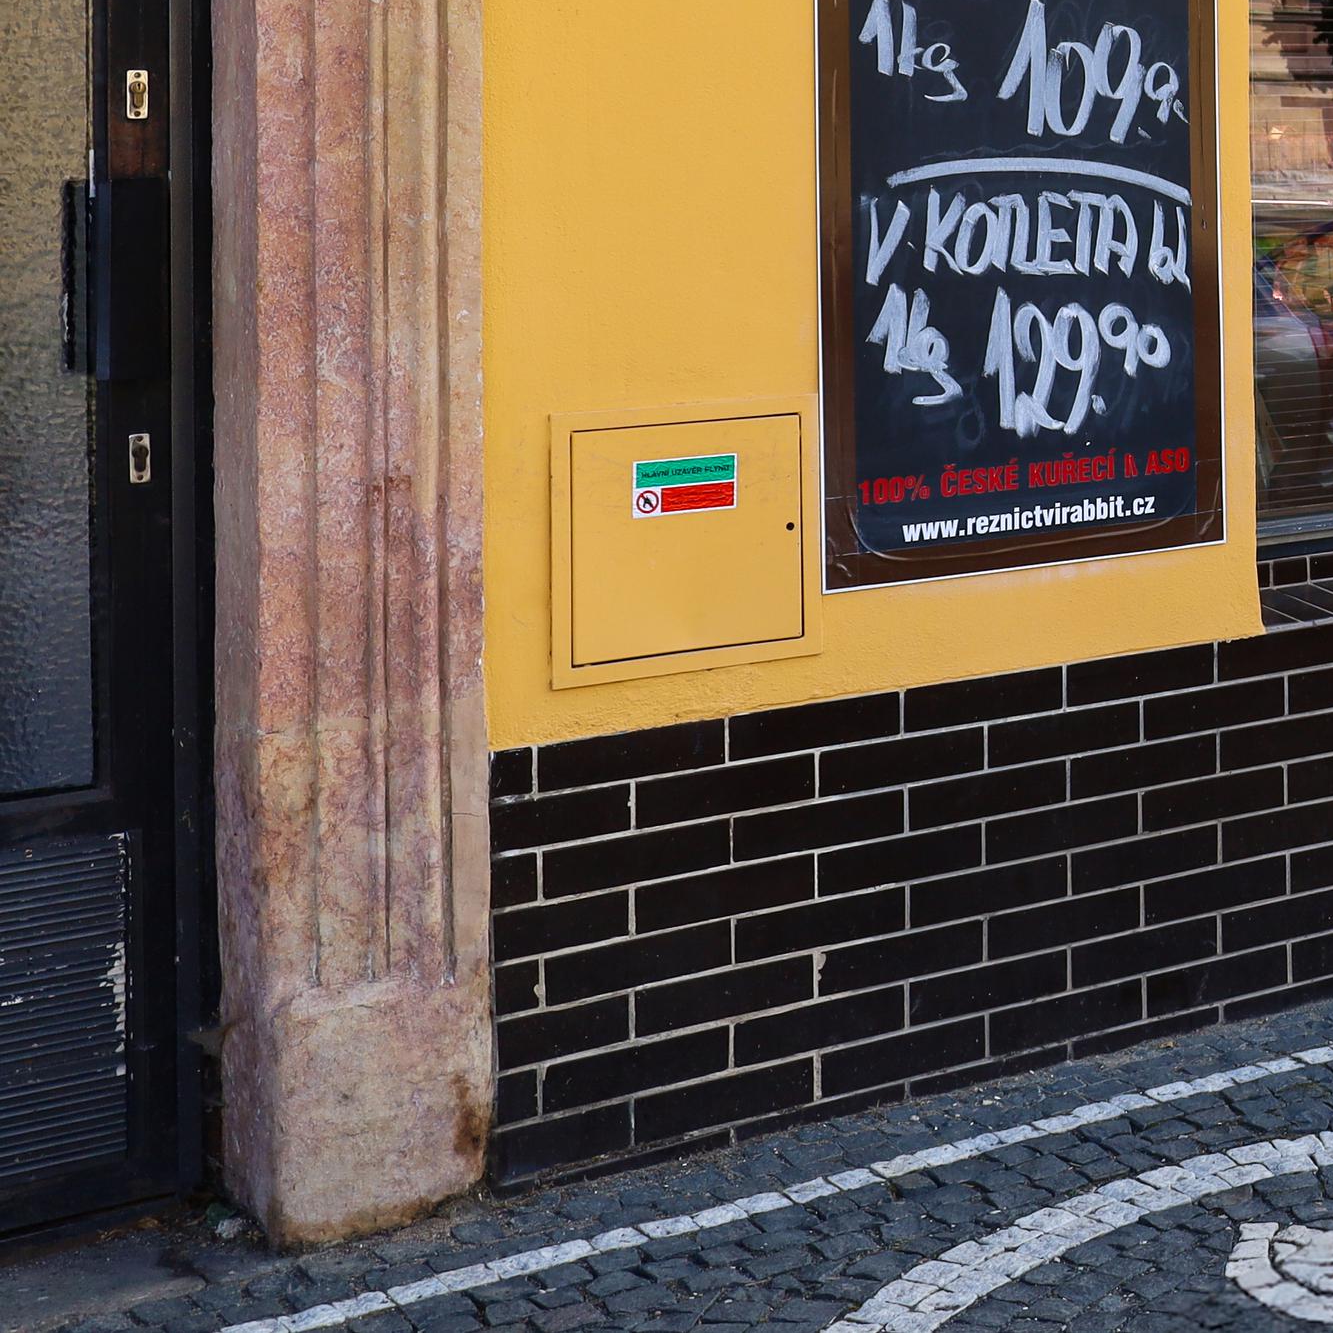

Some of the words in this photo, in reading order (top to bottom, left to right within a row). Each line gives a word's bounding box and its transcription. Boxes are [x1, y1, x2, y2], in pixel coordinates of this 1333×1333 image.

[858, 474, 930, 505] 100%
[940, 459, 1019, 497] ČESKÉ
[1028, 448, 1116, 489] KUŘECÍ
[902, 496, 1155, 543] www.reznictvirabbit.cz
